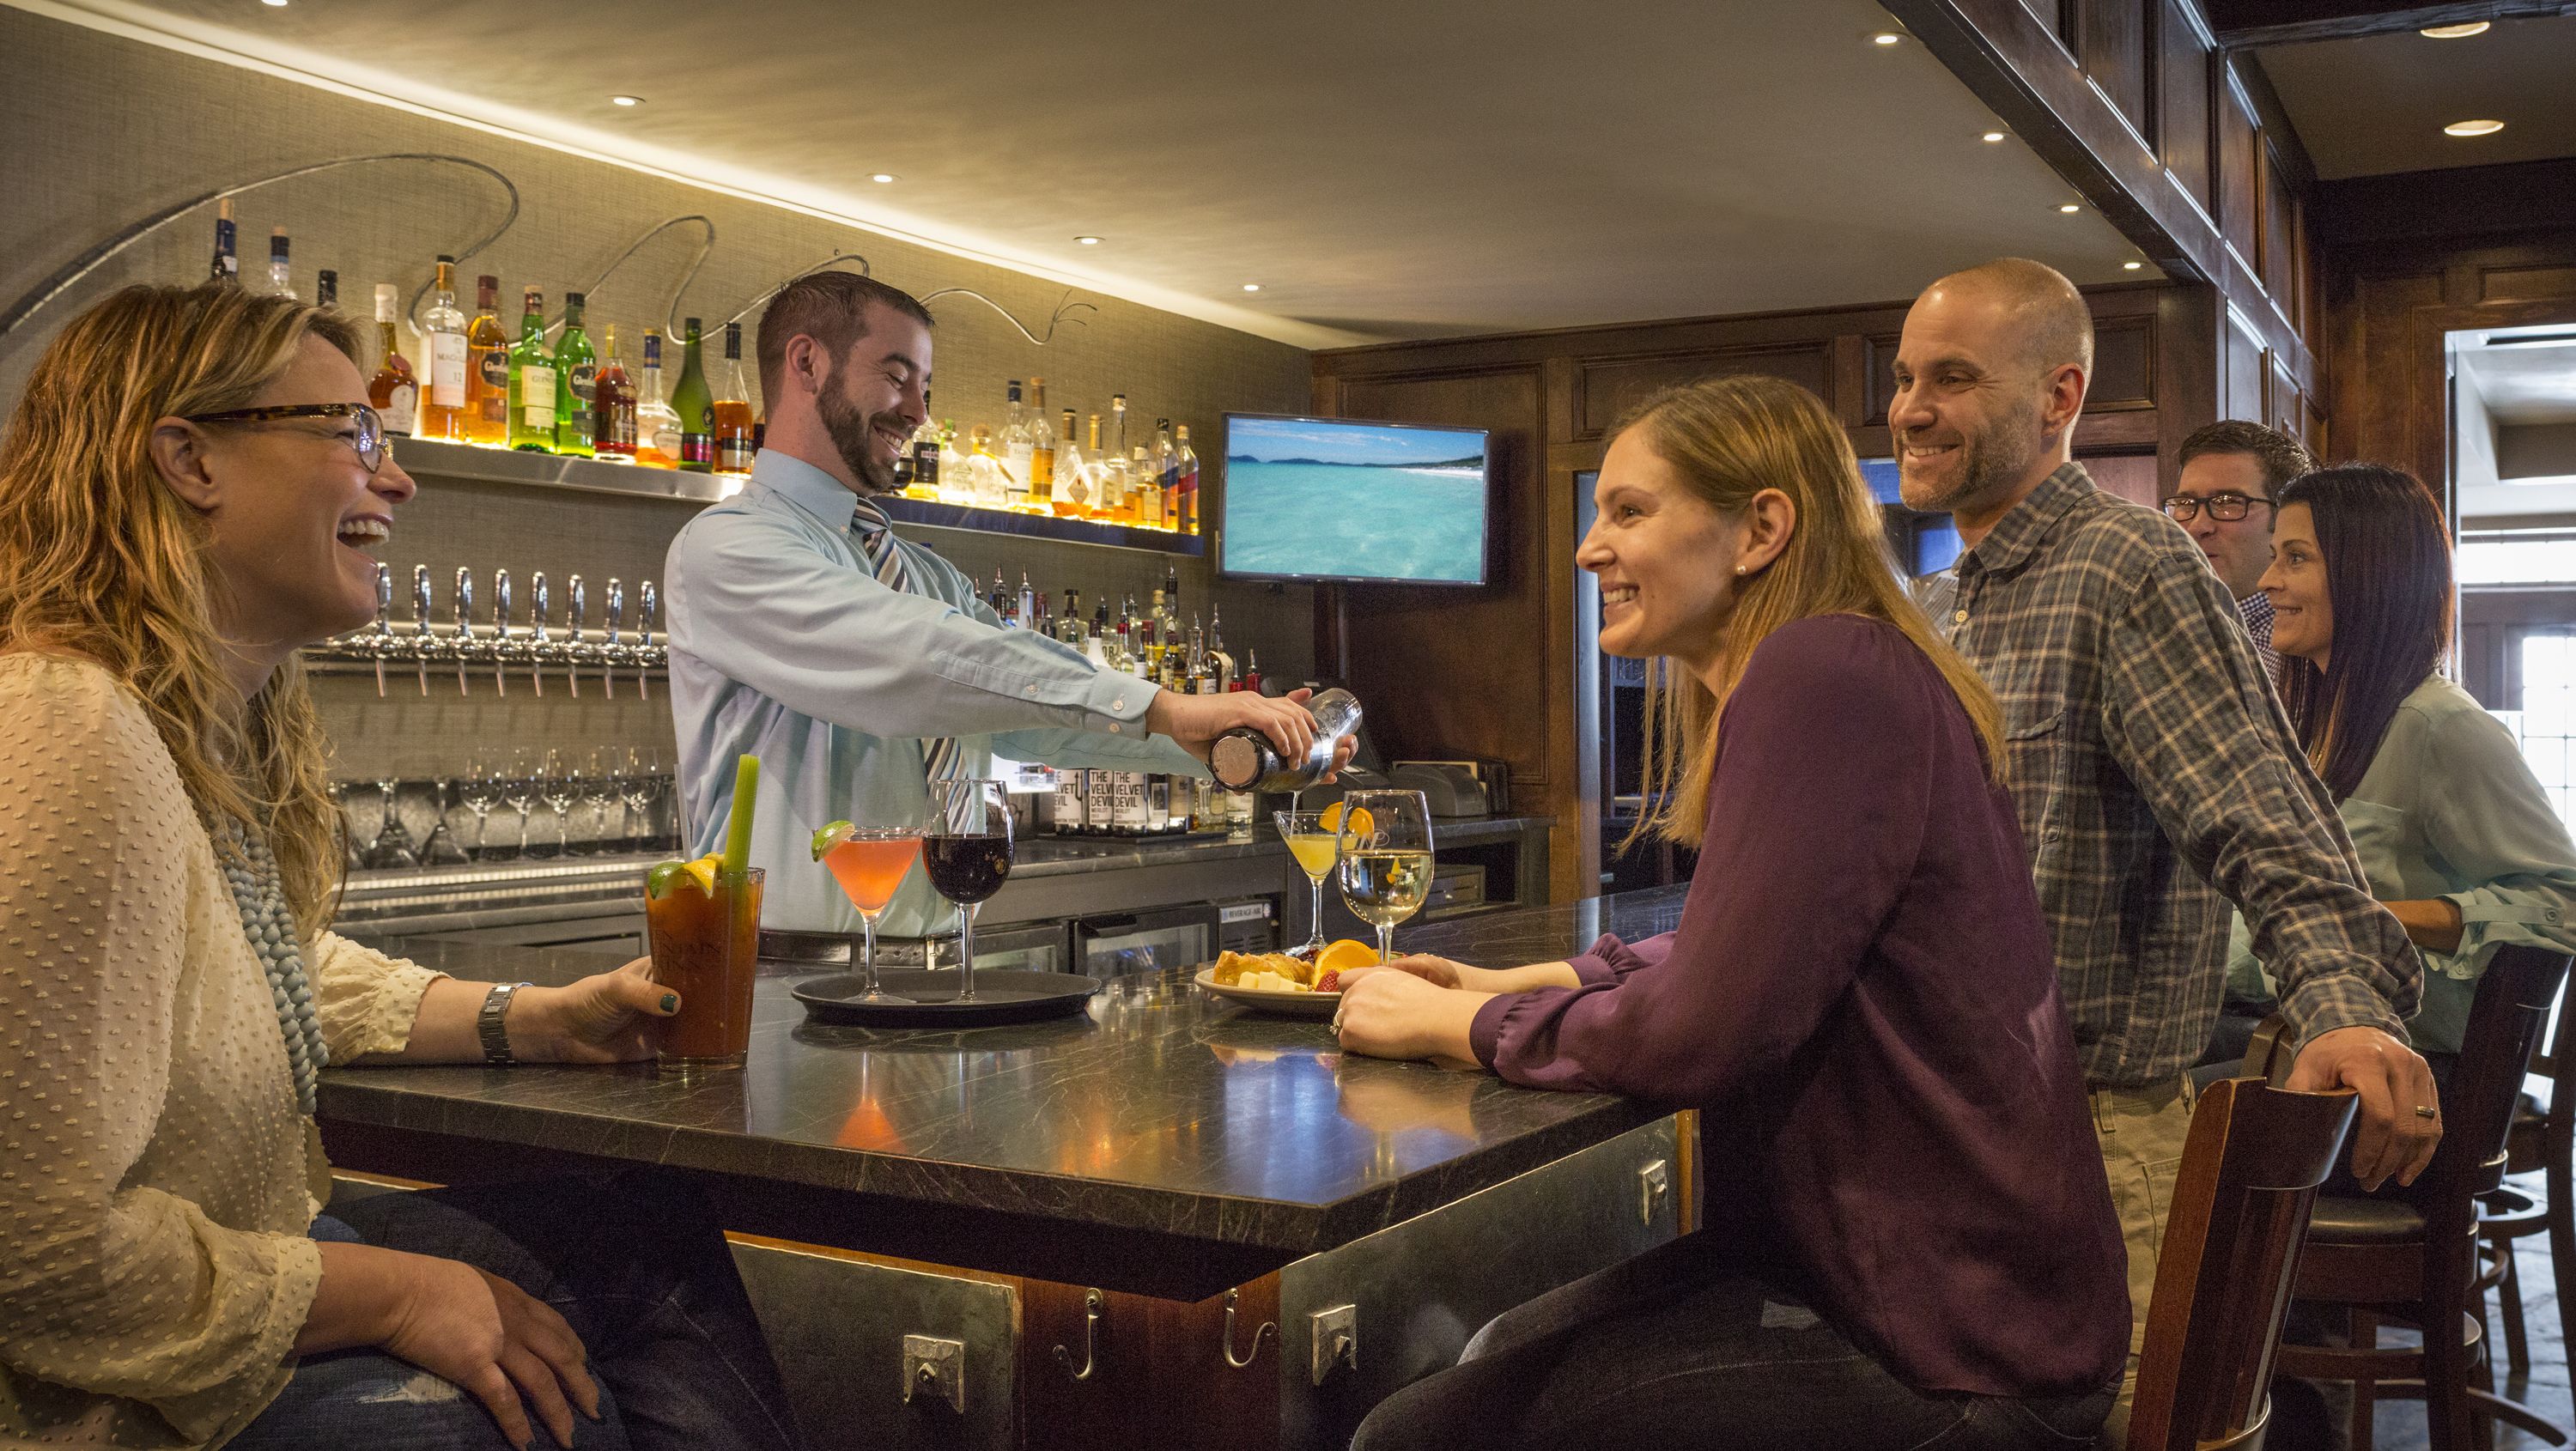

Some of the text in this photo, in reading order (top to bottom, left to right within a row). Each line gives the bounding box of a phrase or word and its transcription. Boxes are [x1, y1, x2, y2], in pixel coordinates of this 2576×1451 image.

[1091, 771, 1108, 782] THE
[1115, 772, 1131, 783] THE
[1115, 784, 1145, 795] VELVET
[1115, 797, 1138, 808] DEVIL
